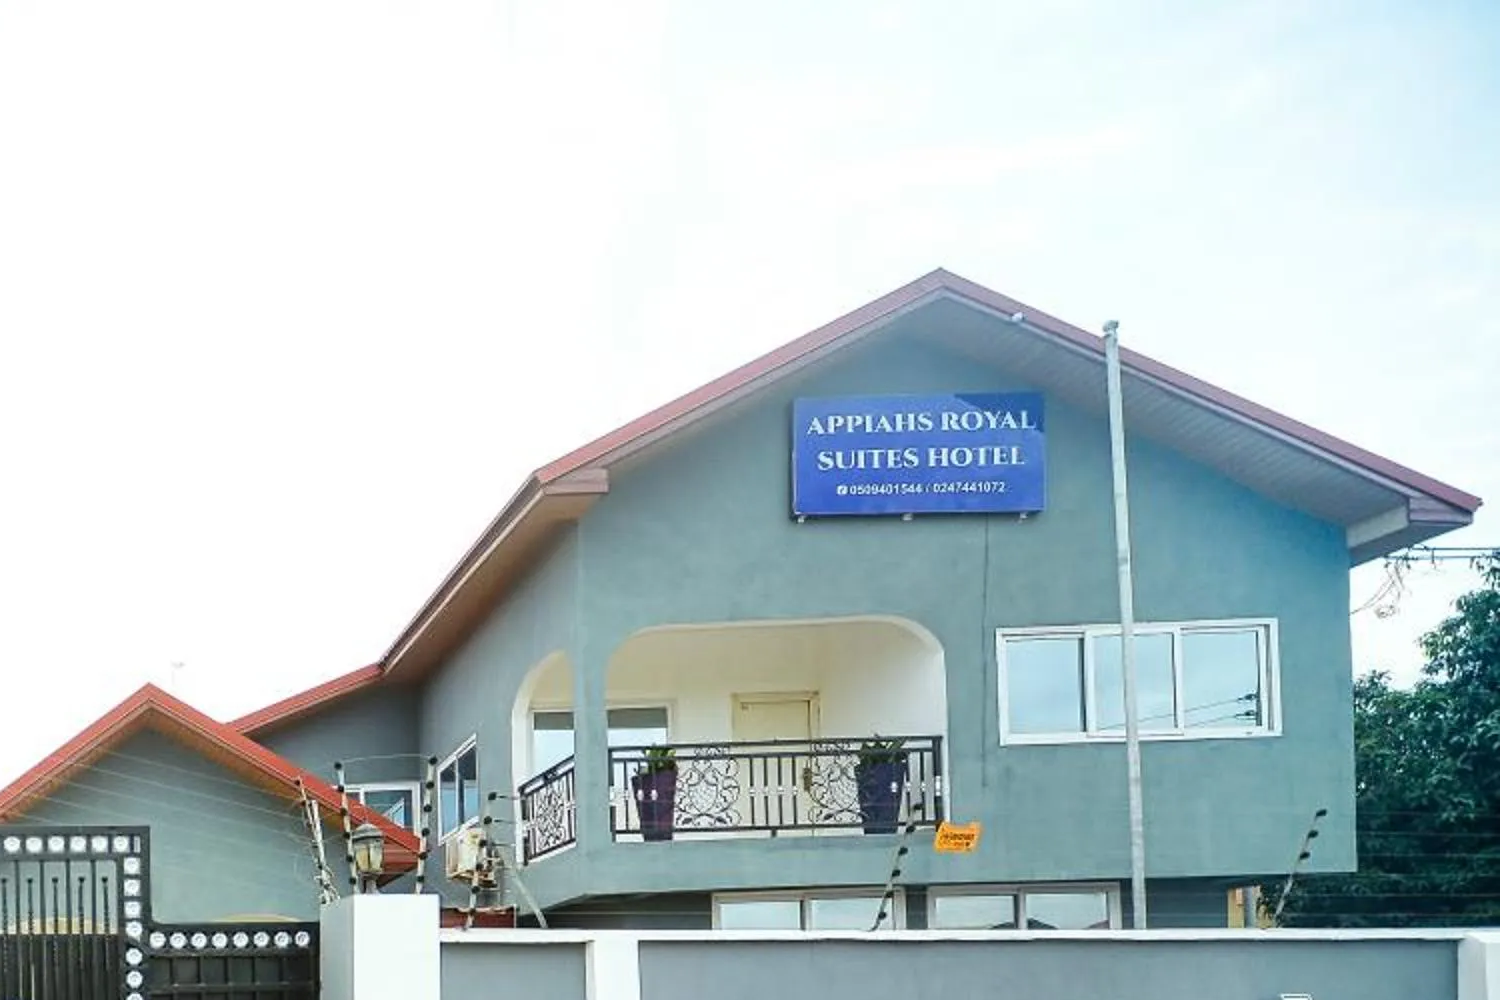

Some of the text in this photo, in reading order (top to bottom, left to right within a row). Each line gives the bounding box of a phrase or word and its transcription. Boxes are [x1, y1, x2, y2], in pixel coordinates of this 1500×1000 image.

[807, 410, 1036, 434] APPIAHS ROYAL
[817, 446, 1025, 471] SUITES HOTEL
